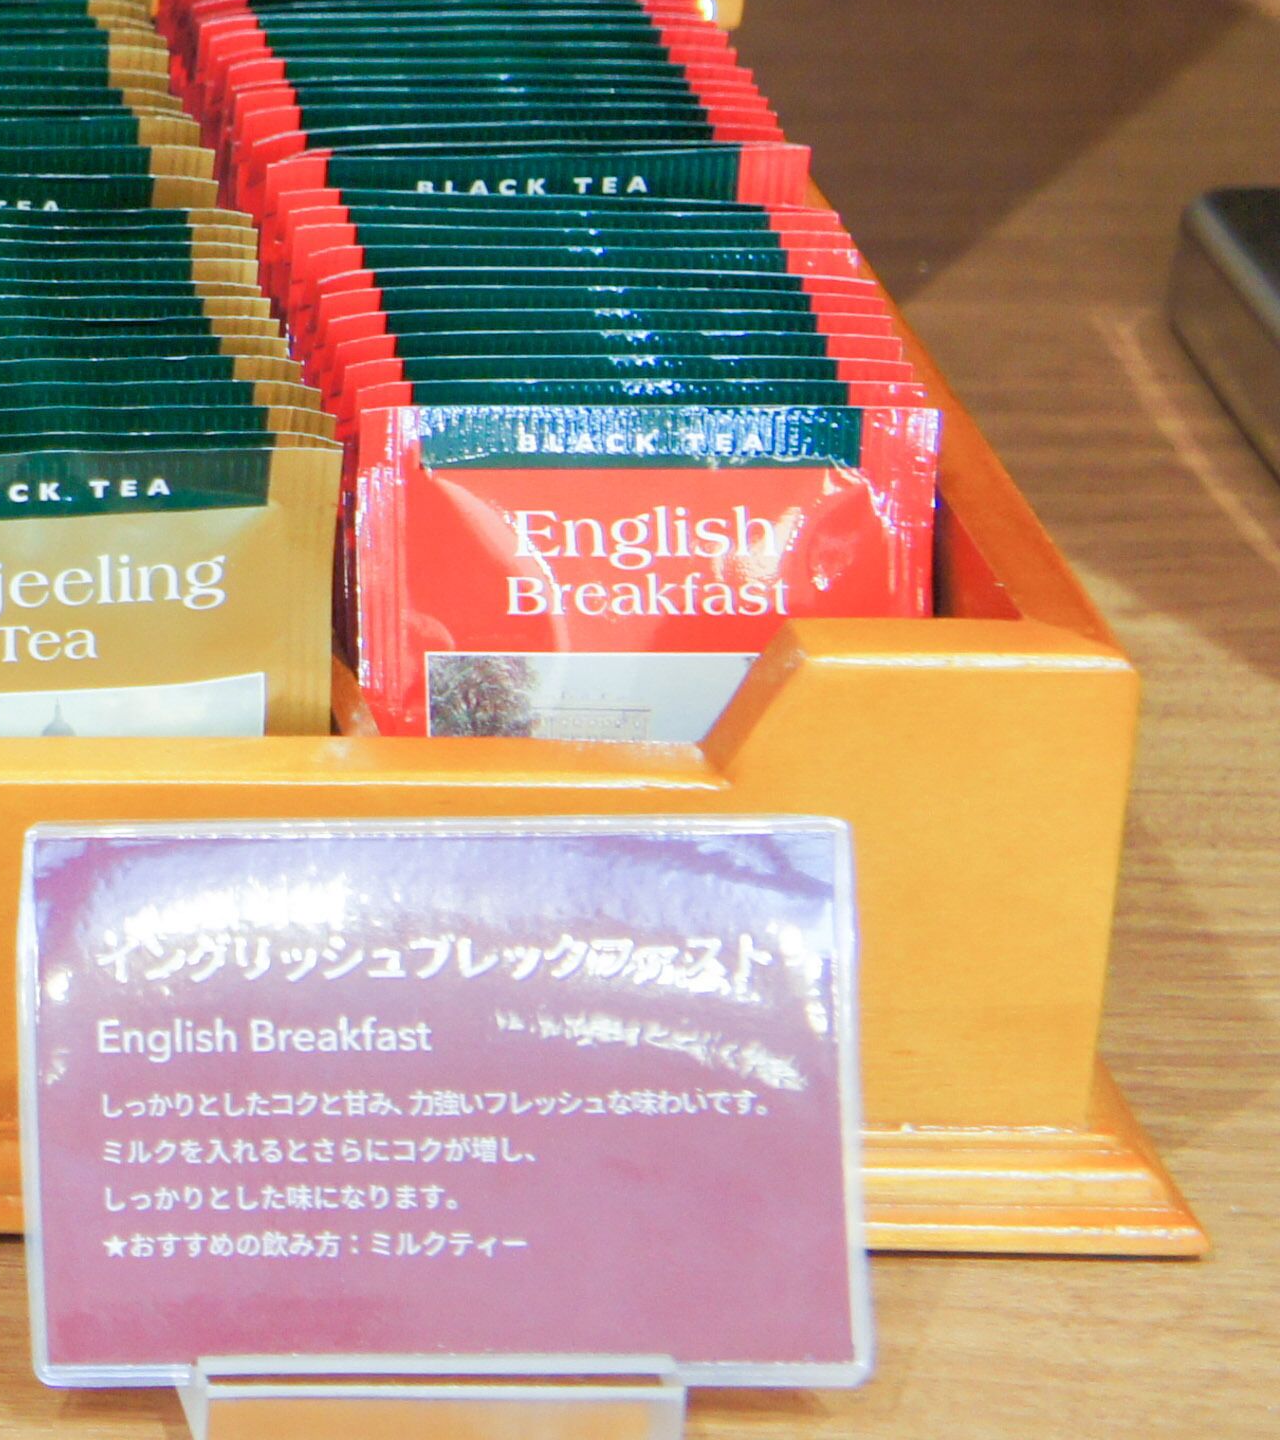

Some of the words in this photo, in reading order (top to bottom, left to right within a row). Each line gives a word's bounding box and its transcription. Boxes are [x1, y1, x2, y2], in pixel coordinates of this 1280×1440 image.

[415, 177, 547, 196] BLACK
[572, 175, 648, 194] TEA
[517, 433, 661, 454] BLACK
[685, 432, 766, 453] TEA
[88, 477, 173, 500] TEA
[511, 504, 782, 570] English
[505, 573, 789, 617] Breakfast
[95, 932, 774, 990] イングリッシュブレックファスト
[96, 1016, 238, 1063] English
[249, 1014, 433, 1054] Breakfast
[99, 1088, 769, 1118] しっかりとしたコクと甘み、力強いフレッシュな味わいです。
[102, 1137, 537, 1165] ミルクを入れるとさらにコクが増し、
[102, 1184, 461, 1213] しっかりとした味になります。
